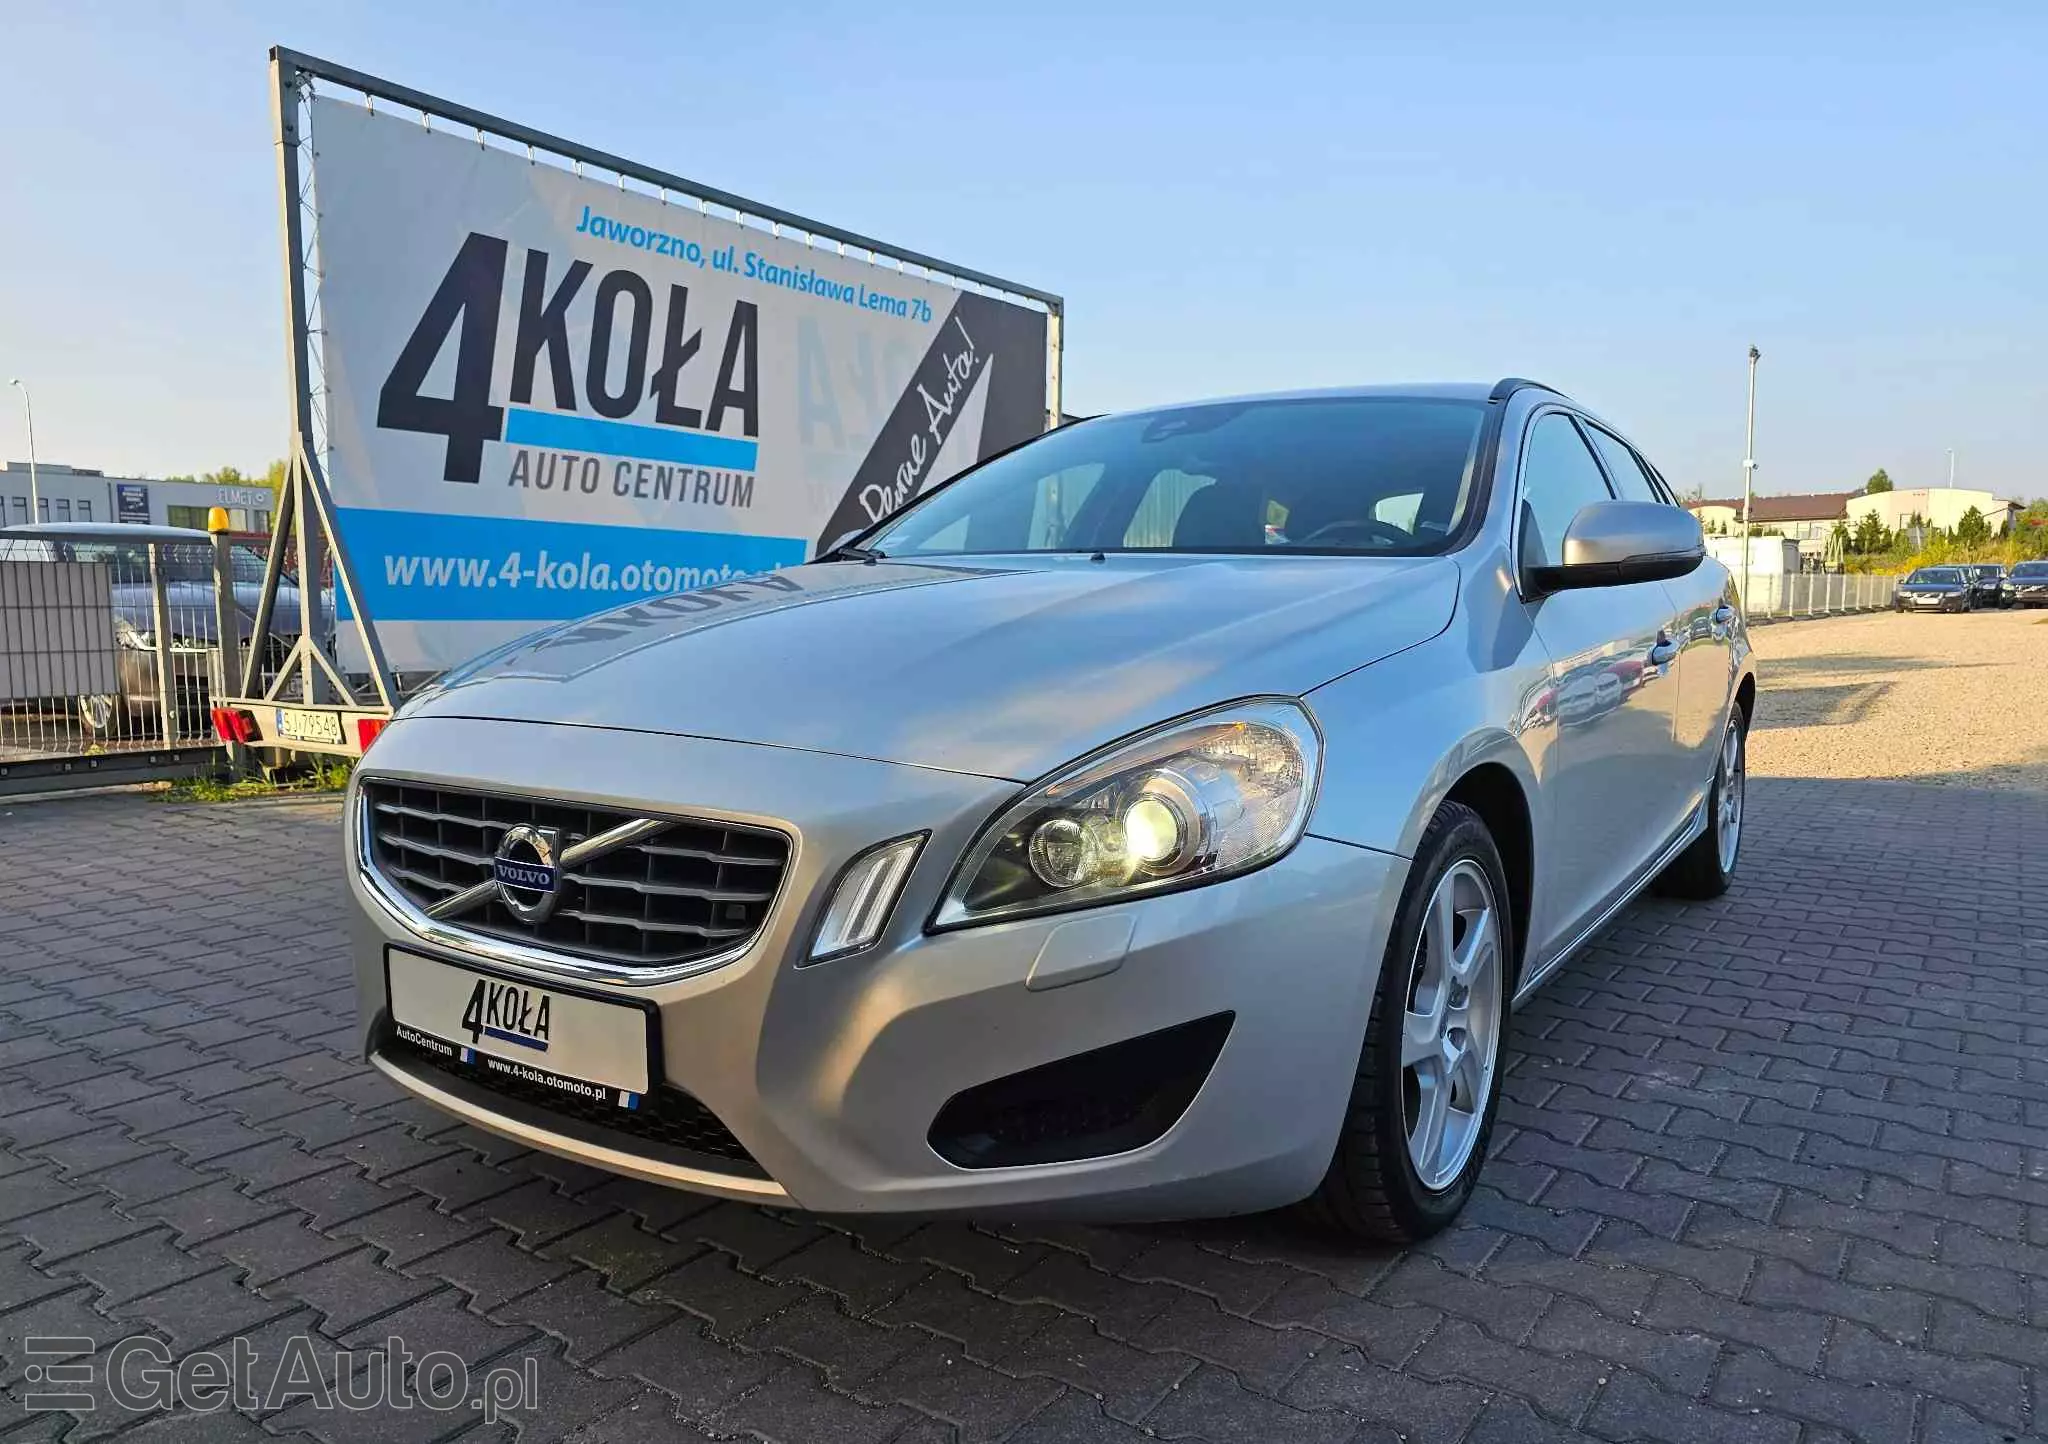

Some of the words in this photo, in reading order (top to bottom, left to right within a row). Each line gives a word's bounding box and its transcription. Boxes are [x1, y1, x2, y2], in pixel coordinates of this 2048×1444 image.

[576, 205, 705, 269] Jaworzno,
[712, 245, 739, 275] ul.
[743, 252, 855, 304] Stanisława
[859, 283, 907, 318] Lema
[911, 298, 932, 323] 7b
[917, 316, 981, 445] Auta!
[508, 449, 600, 494] AUTO
[613, 460, 755, 508] CENTRUM
[384, 550, 782, 592] www.4-kola.otomot
[497, 864, 550, 885] VOLVO
[396, 1025, 453, 1057] AutoCentrum
[487, 1057, 606, 1100] www.4-kola.otomoto.pl
